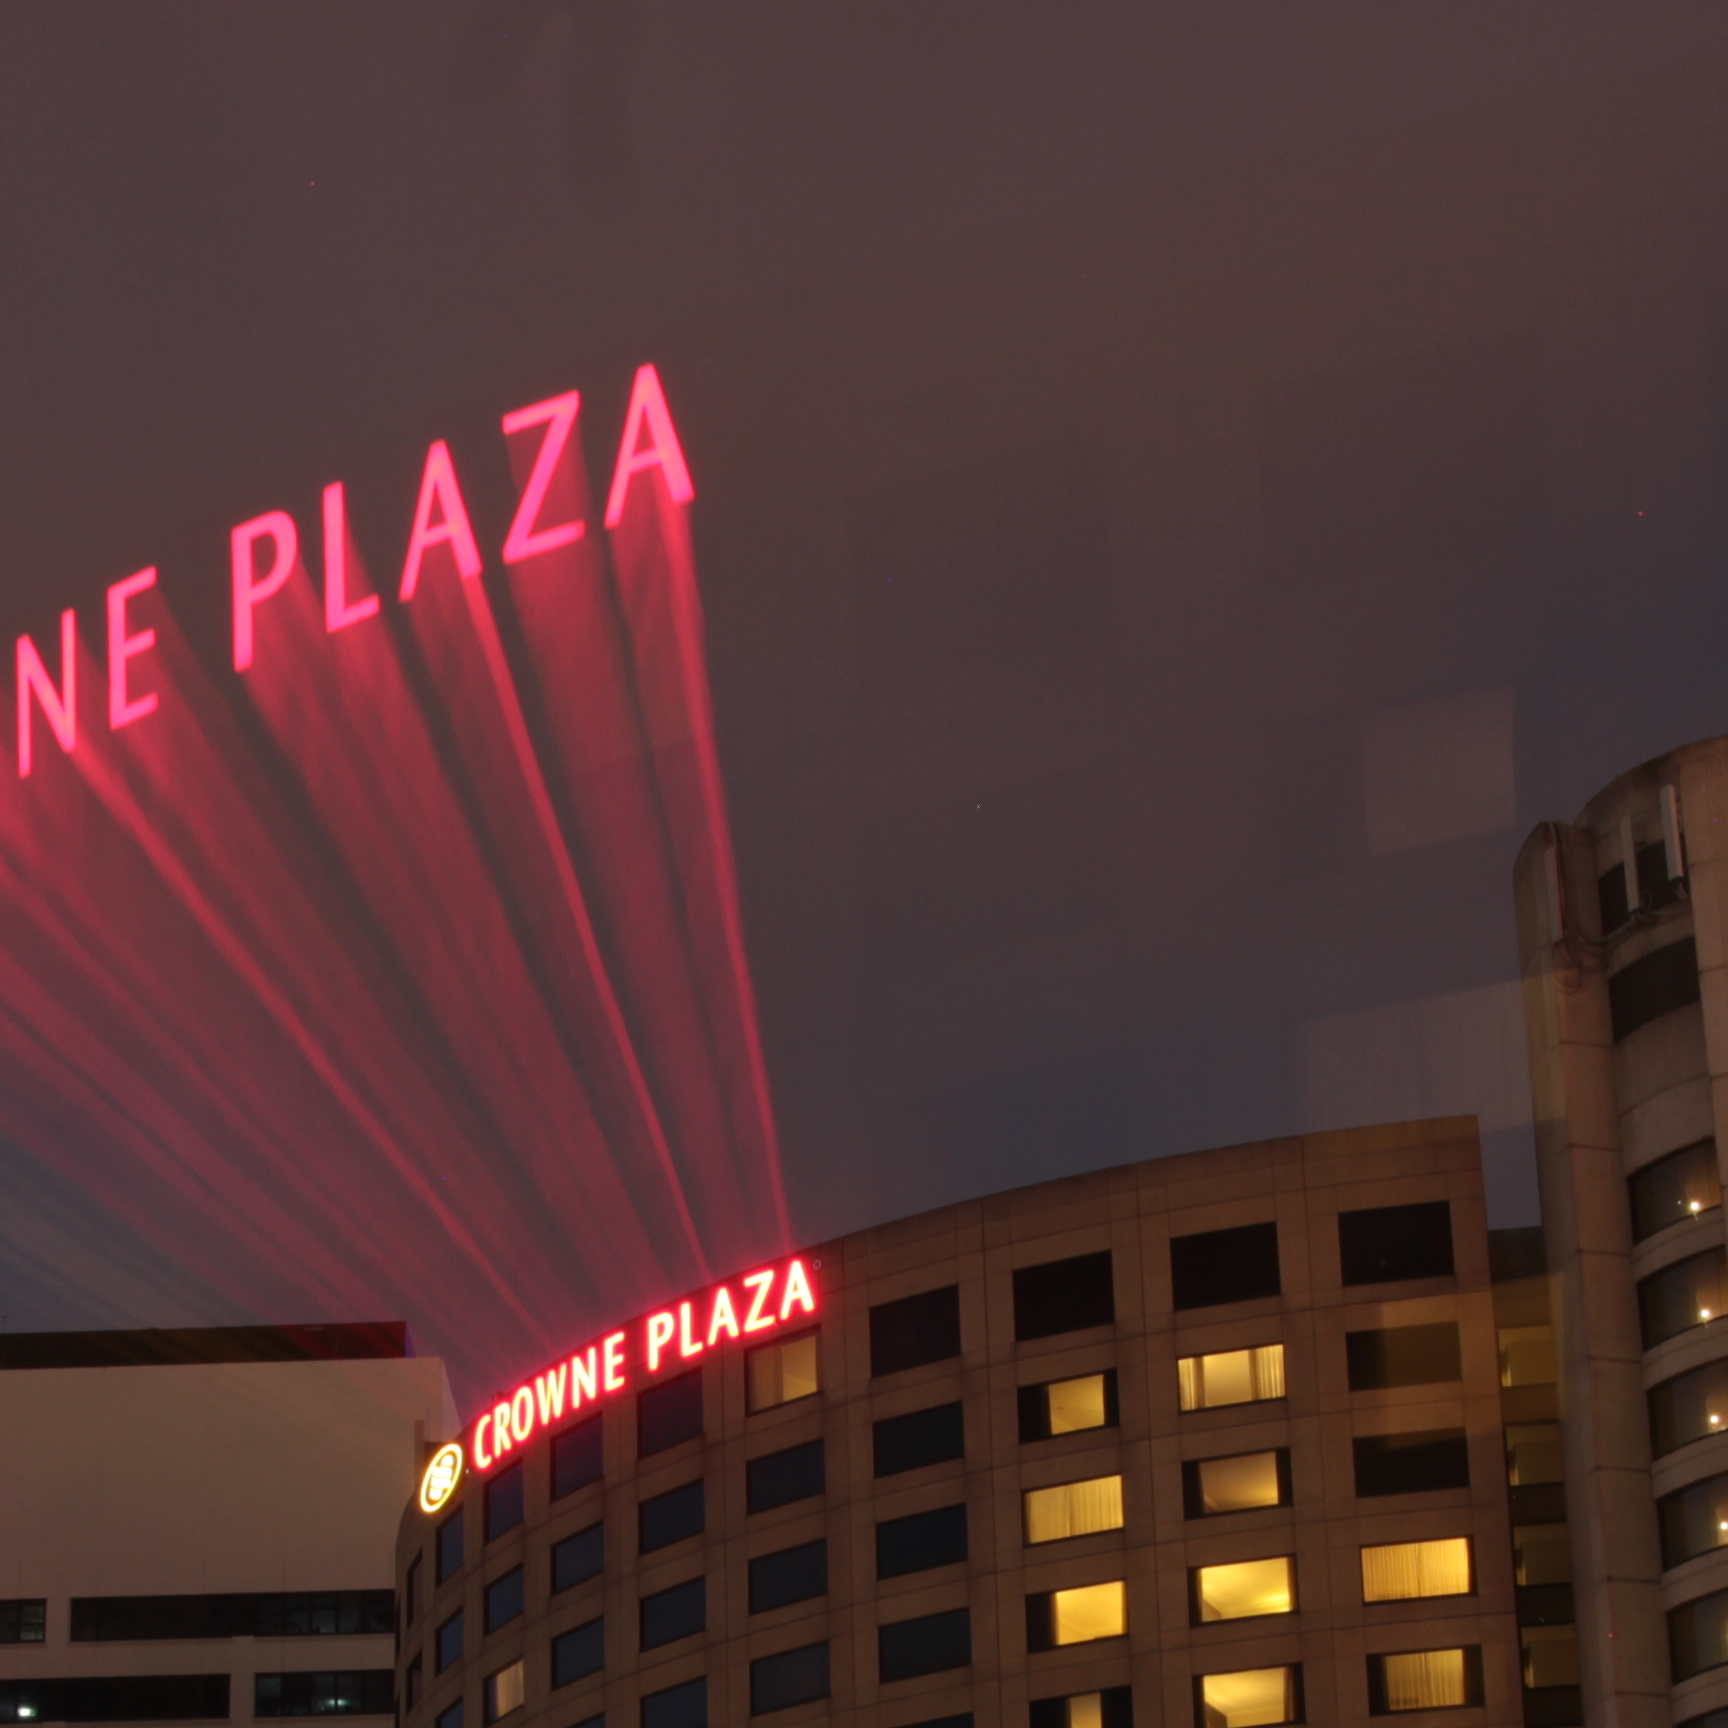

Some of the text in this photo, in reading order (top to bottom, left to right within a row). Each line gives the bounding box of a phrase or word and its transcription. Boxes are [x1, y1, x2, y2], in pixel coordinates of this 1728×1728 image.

[230, 363, 695, 671] PLAZA
[471, 1258, 816, 1471] CROWNE PLAZA
